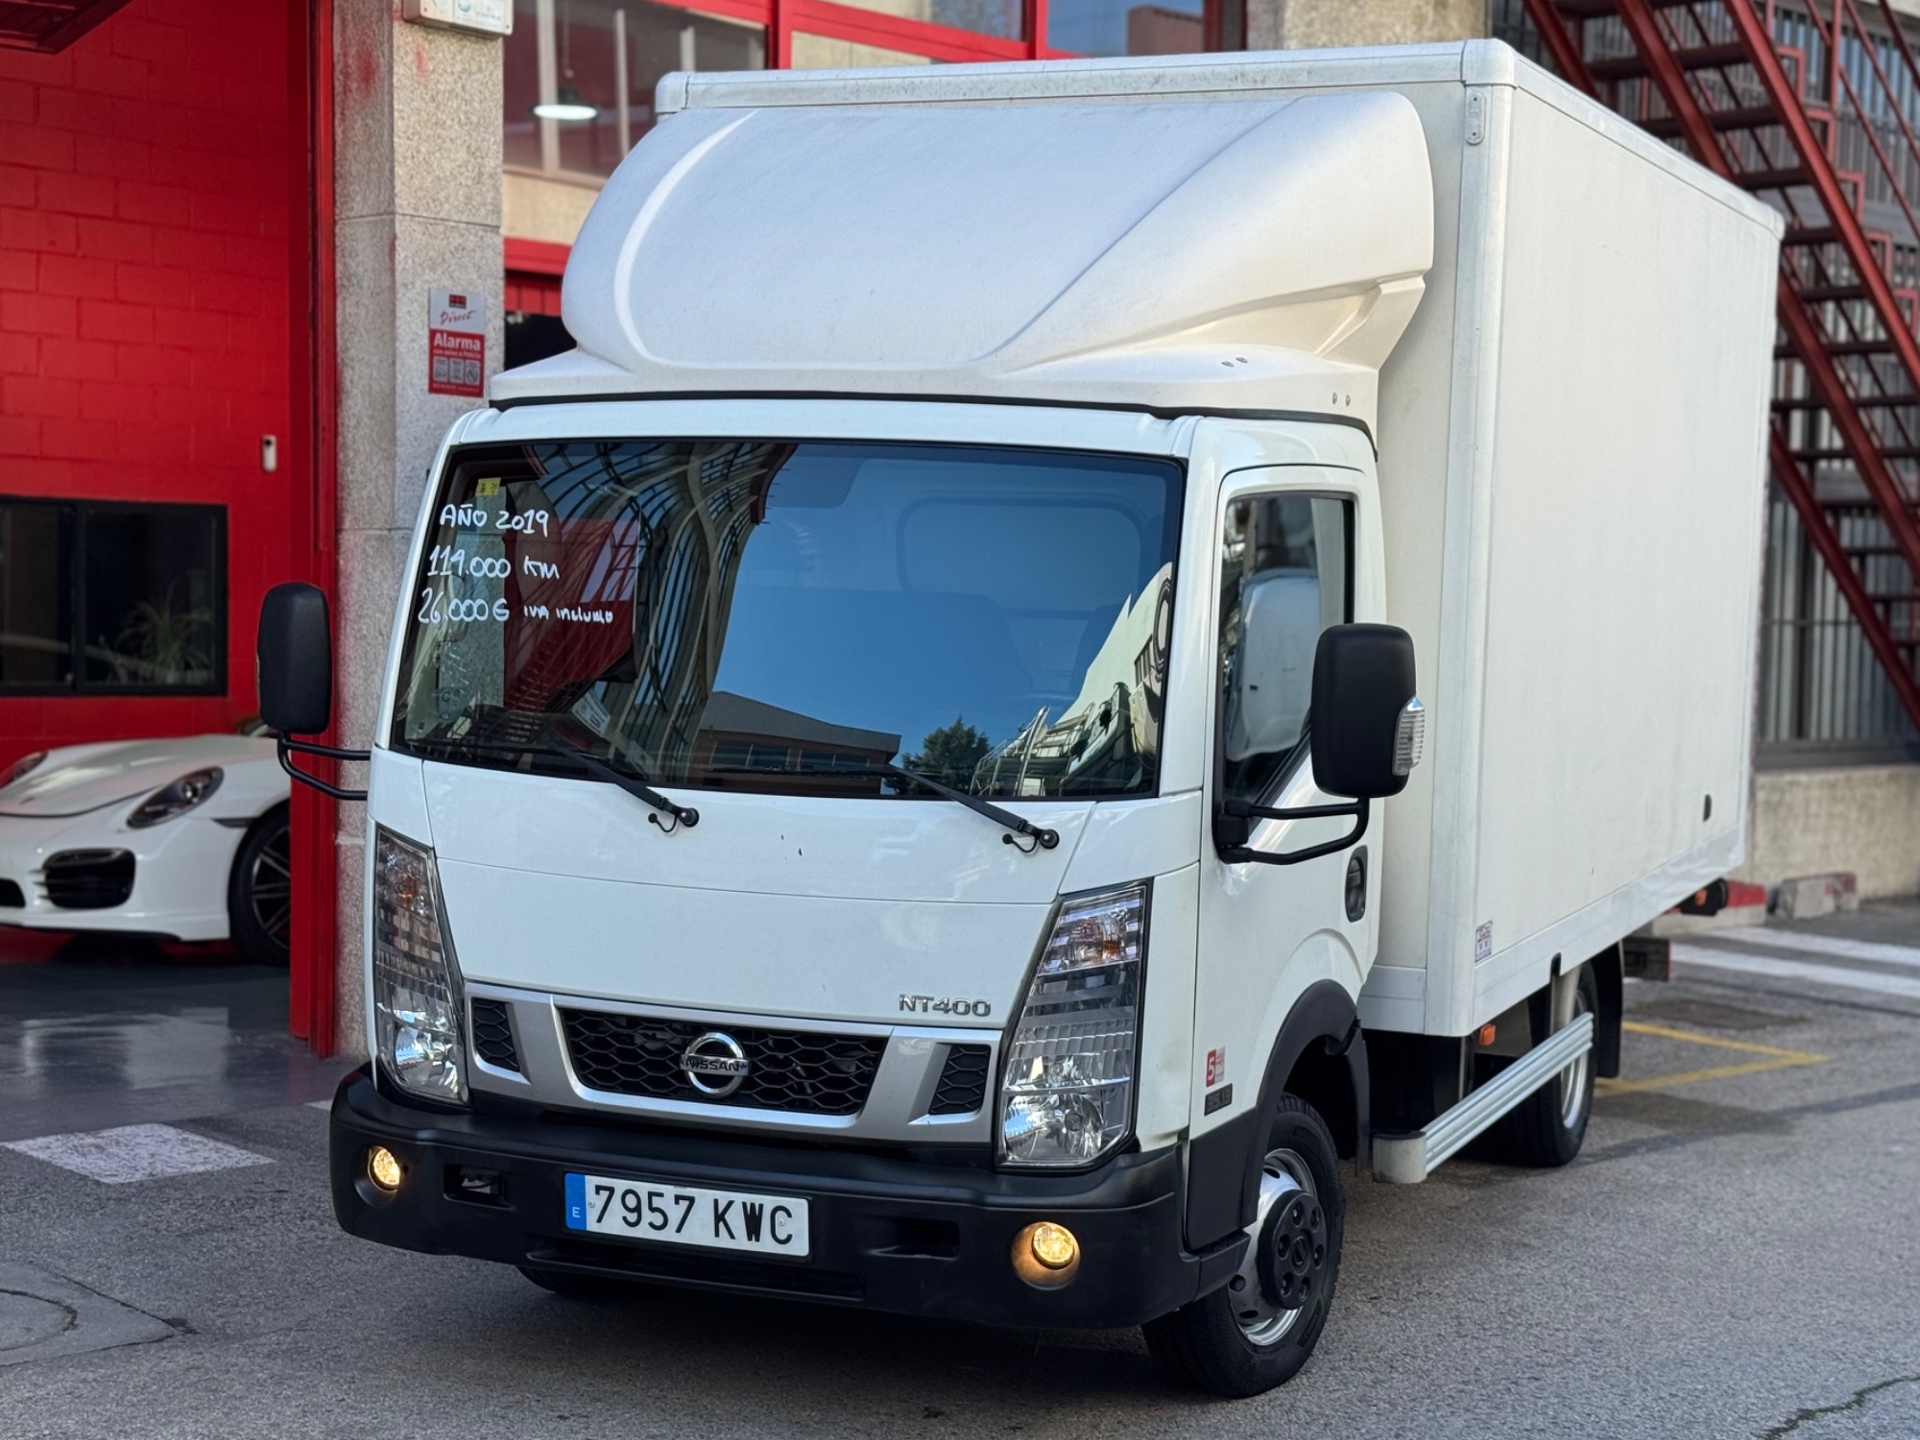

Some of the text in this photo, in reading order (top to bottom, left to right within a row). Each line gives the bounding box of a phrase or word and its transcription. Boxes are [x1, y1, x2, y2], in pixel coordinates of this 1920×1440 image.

[434, 332, 481, 351] Alarma
[440, 503, 549, 538] AÑO 2019
[899, 994, 992, 1017] NT400
[685, 1057, 740, 1073] NISSAN
[1207, 1055, 1215, 1081] 5
[572, 1206, 581, 1218] E
[594, 1184, 794, 1245] 7957 KWC
